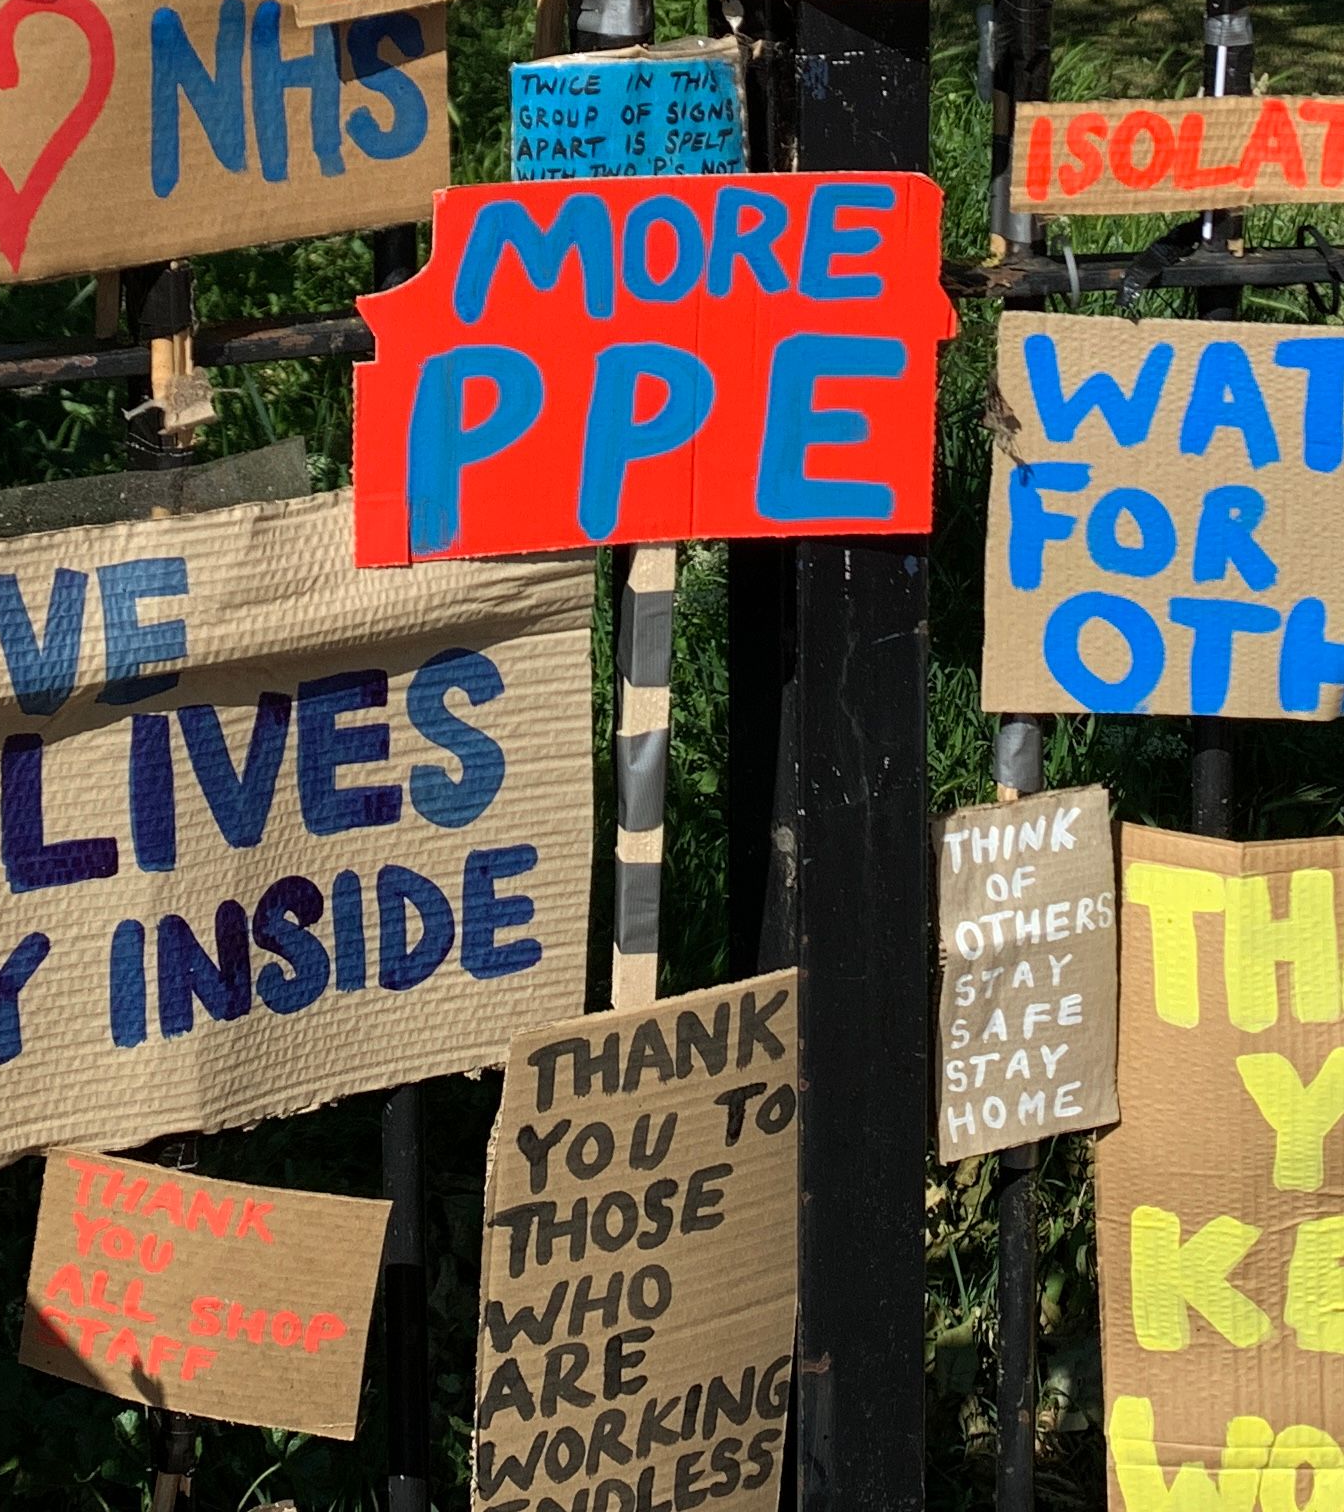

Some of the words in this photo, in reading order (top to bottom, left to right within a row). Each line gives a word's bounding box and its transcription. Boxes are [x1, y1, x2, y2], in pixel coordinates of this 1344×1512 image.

[518, 104, 600, 130] GROUP
[620, 102, 654, 126] OF
[665, 98, 735, 126] SIGNS
[521, 73, 602, 96] TWICE
[625, 72, 654, 93] IN
[670, 70, 721, 93] THIS
[516, 134, 608, 163] APART
[624, 129, 647, 156] IS
[664, 126, 735, 155] SPELT
[454, 182, 898, 326] MORE
[406, 331, 910, 558] PPE
[1008, 462, 1280, 593] FOR
[0, 646, 508, 895] LIVES
[942, 806, 1083, 875] THINK
[985, 864, 1037, 903] OF
[108, 843, 544, 1049] INSIDE
[954, 891, 1114, 962] OTHERS
[950, 993, 1084, 1051] SAFE
[954, 952, 1074, 1008] STAY
[527, 988, 791, 1114] THANK
[945, 1042, 1070, 1094] STAY
[516, 1110, 680, 1196] YOU
[713, 1080, 798, 1148] TO
[946, 1079, 1084, 1145] HOME
[66, 1156, 276, 1246] THANK
[71, 1209, 175, 1275] YOU
[486, 1162, 735, 1280] THOSE
[37, 1304, 219, 1383] STAFF
[43, 1261, 157, 1324] ALL
[187, 1294, 348, 1354] SHOP
[485, 1263, 673, 1355] WHO
[478, 1325, 656, 1431] ARE
[476, 1354, 794, 1502] WORKING
